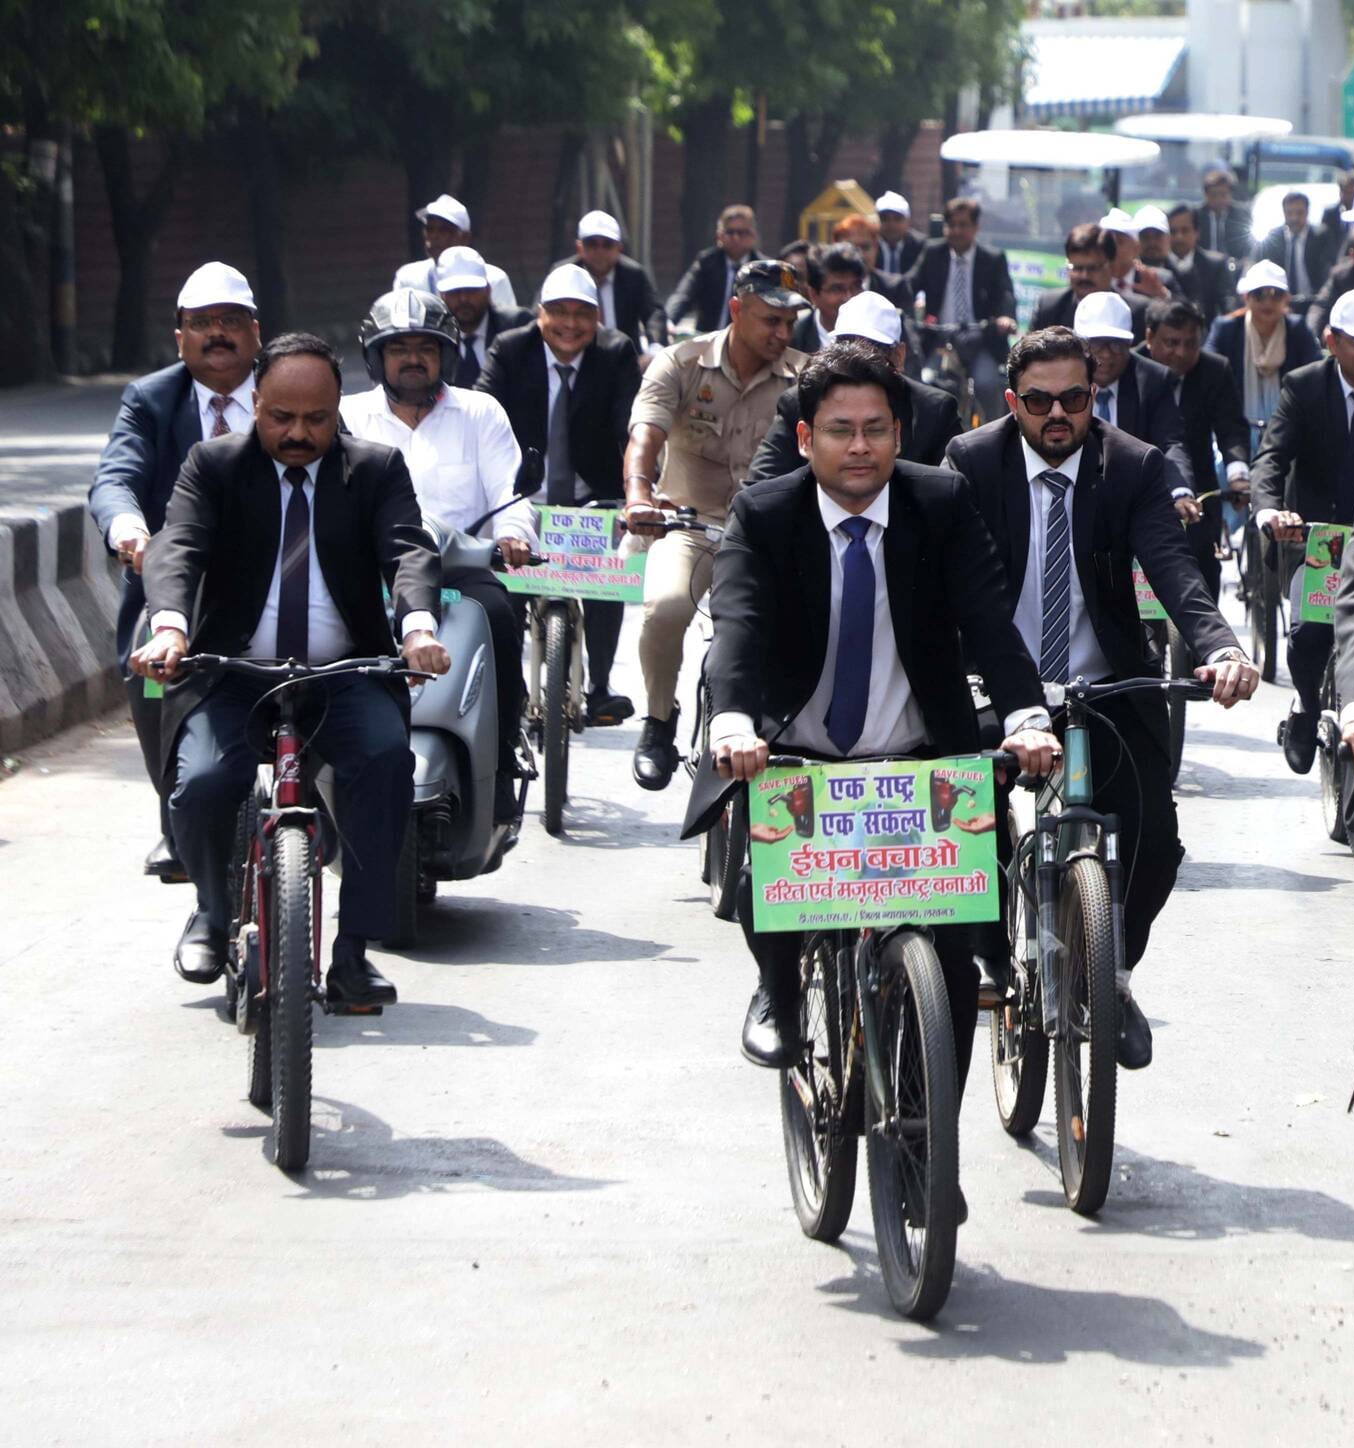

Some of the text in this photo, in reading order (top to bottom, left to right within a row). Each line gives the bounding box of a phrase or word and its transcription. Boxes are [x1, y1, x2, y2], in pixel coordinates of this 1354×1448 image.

[828, 775, 915, 803] एक राष्ट्र
[820, 804, 926, 836] एक संकल्प
[868, 839, 958, 871] बचाओ
[765, 878, 806, 903] हरित
[809, 876, 833, 899] एवं
[896, 879, 932, 899] राष्ट्र
[933, 873, 987, 894] बनाओ
